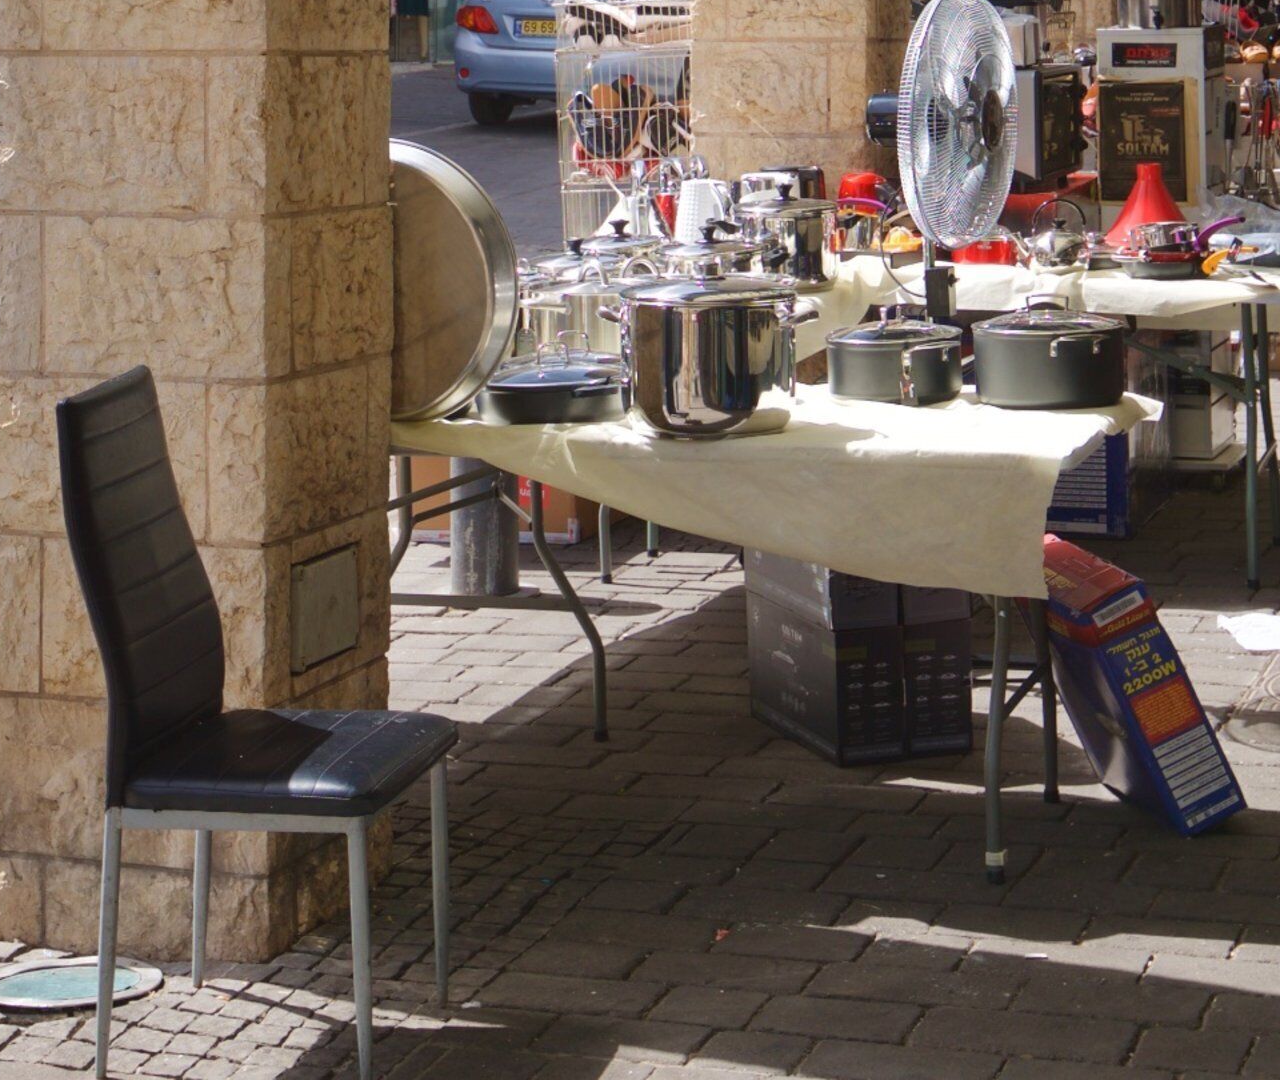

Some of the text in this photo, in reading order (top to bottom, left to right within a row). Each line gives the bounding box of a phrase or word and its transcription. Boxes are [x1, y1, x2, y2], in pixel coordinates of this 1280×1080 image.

[1117, 142, 1169, 156] SOLTAM
[1126, 642, 1150, 662] ענק
[1152, 653, 1162, 664] 2
[1123, 660, 1177, 695] 2200W
